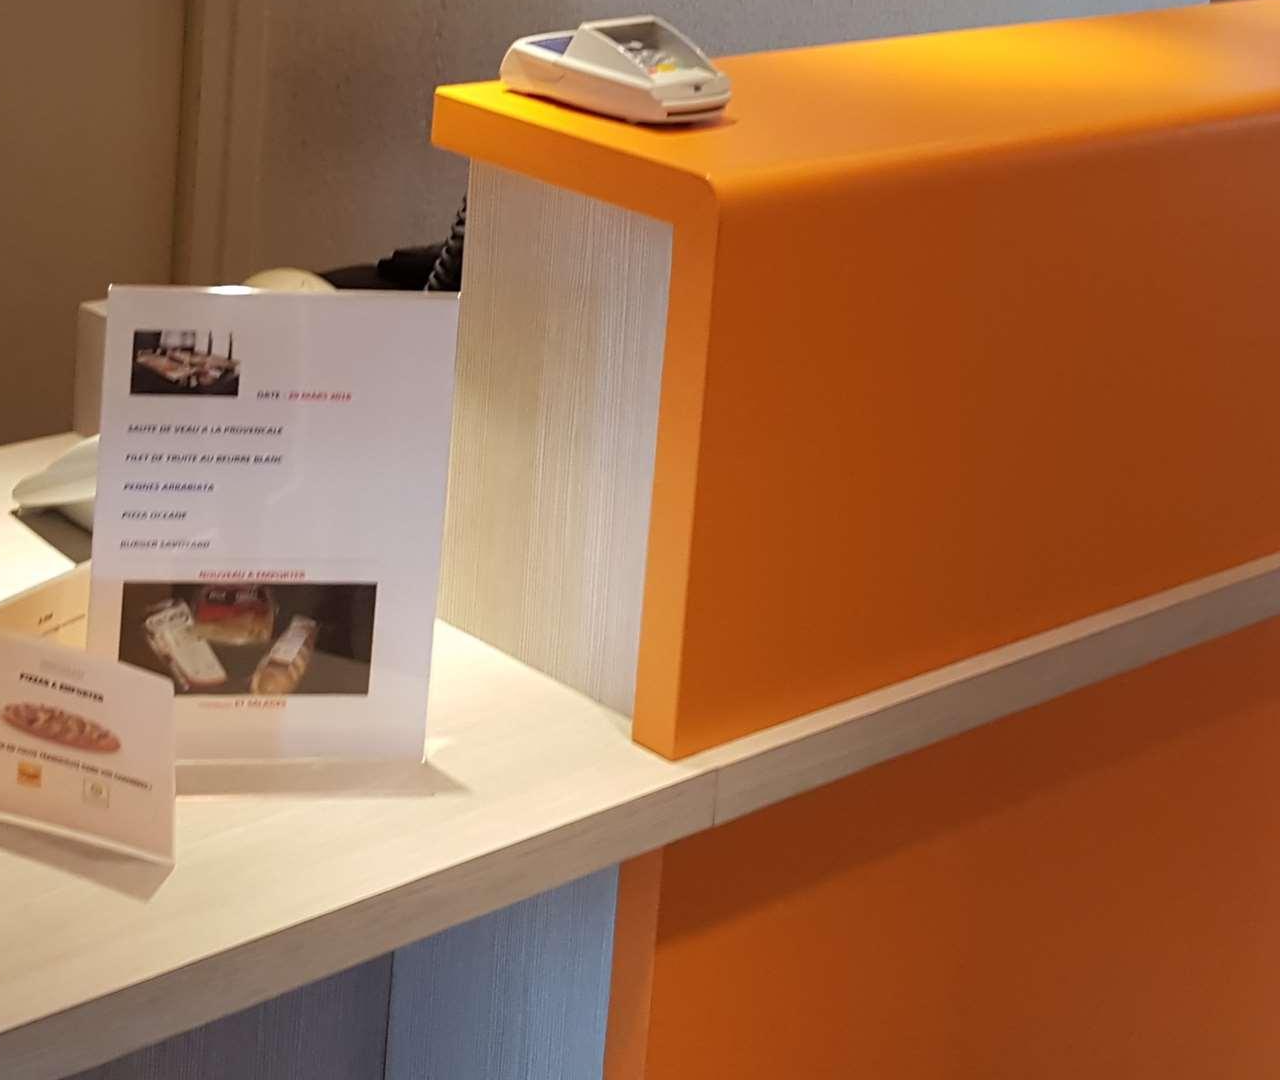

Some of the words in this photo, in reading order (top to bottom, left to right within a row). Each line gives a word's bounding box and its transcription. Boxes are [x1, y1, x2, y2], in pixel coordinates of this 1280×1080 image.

[159, 424, 172, 434] DE
[174, 424, 200, 435] VEAU
[210, 425, 222, 435] LA
[150, 453, 163, 463] DE
[199, 454, 214, 464] AU
[215, 454, 251, 464] BEURRE
[253, 454, 283, 465] BLANC
[59, 682, 105, 704] EMPORTER
